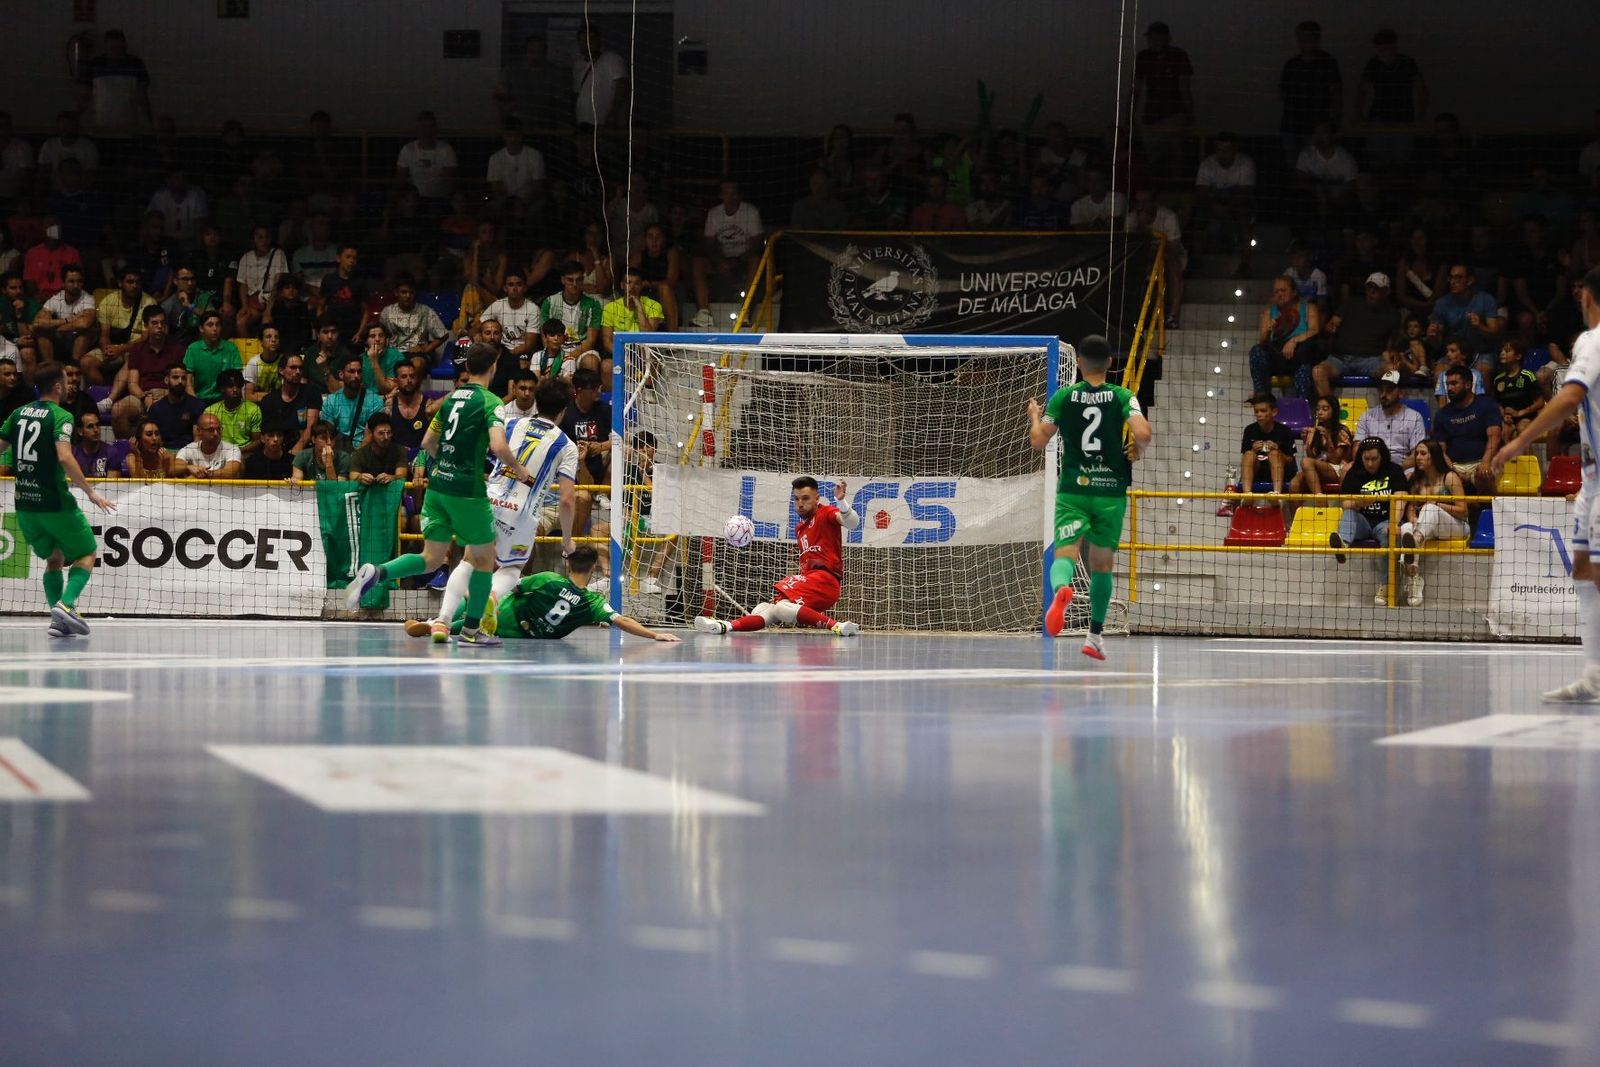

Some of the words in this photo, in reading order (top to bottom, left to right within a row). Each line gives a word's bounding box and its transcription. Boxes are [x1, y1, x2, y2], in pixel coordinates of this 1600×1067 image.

[844, 246, 924, 286] UNIVERSITAS
[959, 266, 1101, 293] UNIVERSIDAD
[844, 288, 922, 326] MALACITANA
[957, 297, 985, 316] DE
[990, 291, 1077, 313] MÁLAGA
[444, 400, 466, 441] 5
[1081, 406, 1102, 451] 2
[17, 418, 42, 462] 12
[519, 436, 542, 466] 7
[92, 525, 313, 572] SOCCER
[558, 587, 581, 605] DAVID
[1510, 582, 1565, 595] diputación
[1568, 585, 1578, 594] d
[544, 599, 571, 626] 8
